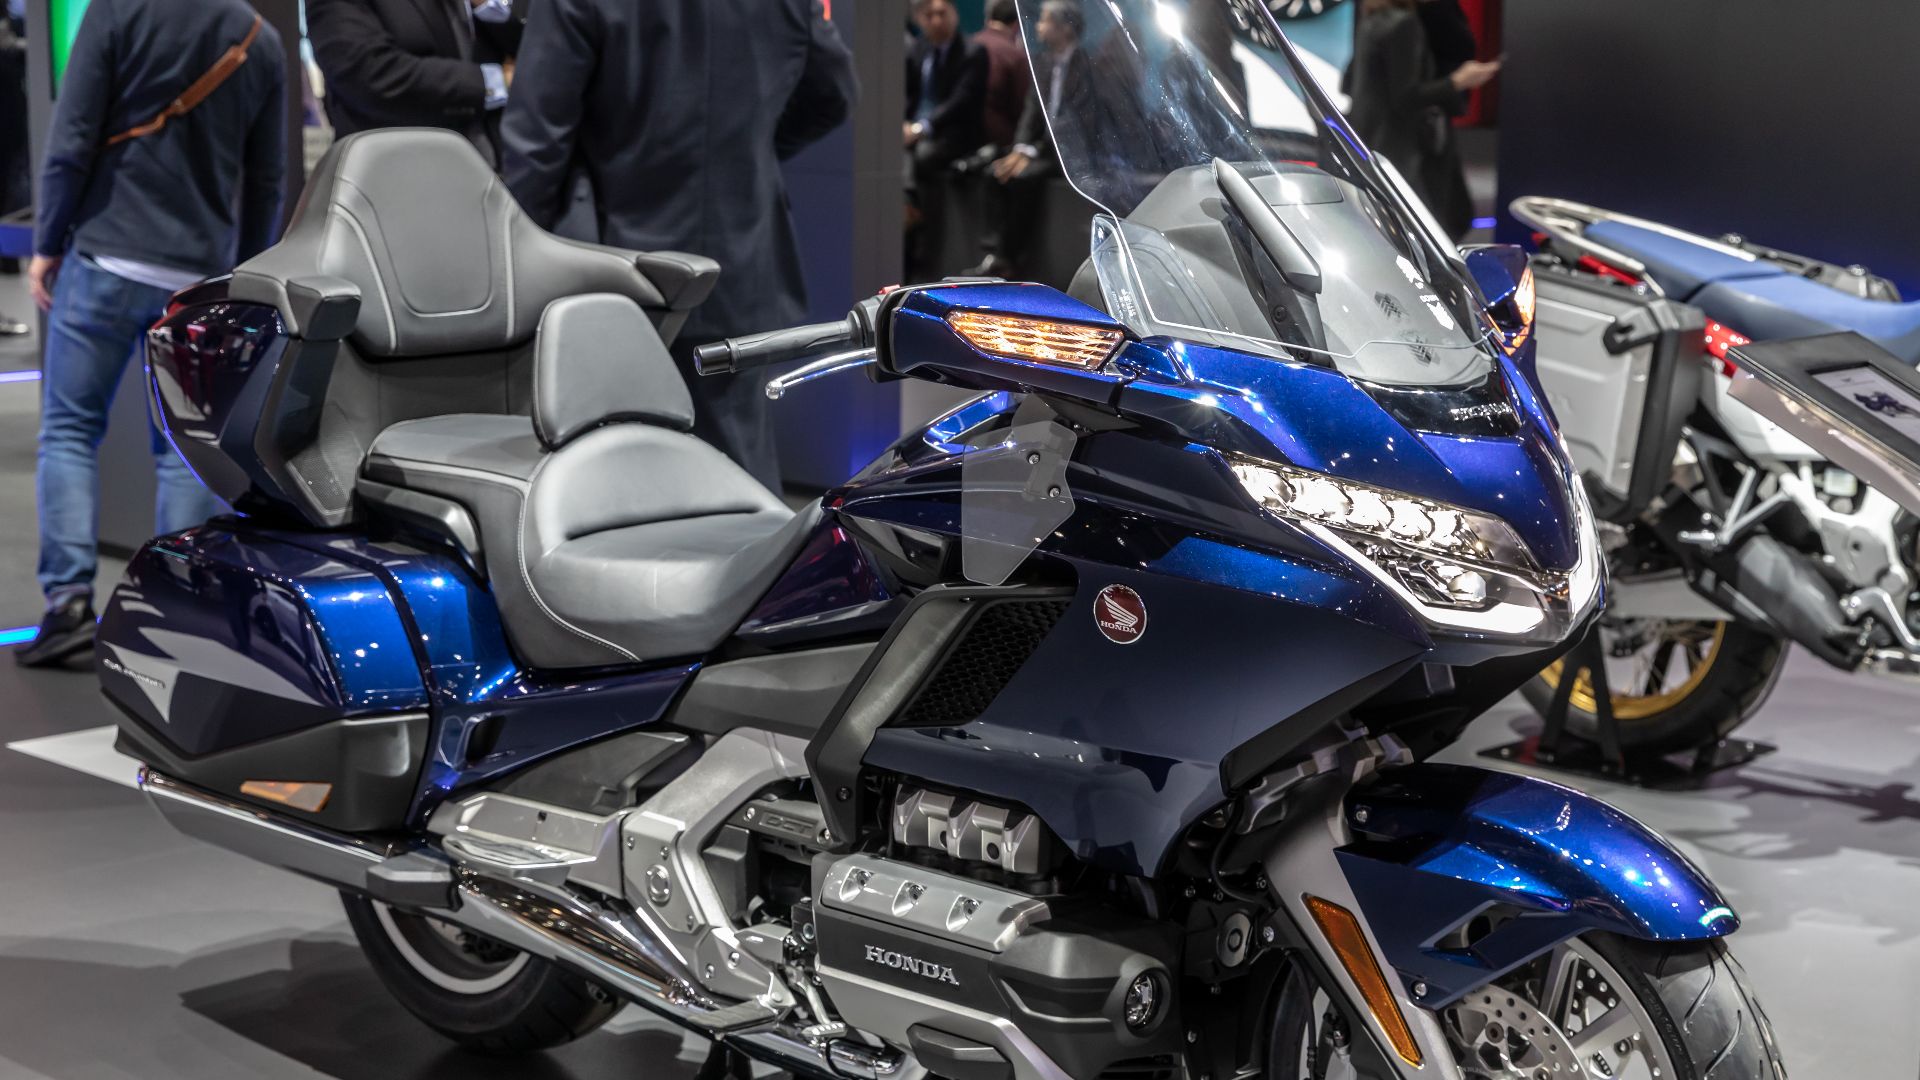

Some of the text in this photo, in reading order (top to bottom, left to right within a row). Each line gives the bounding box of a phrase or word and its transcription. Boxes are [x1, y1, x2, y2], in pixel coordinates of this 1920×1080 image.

[1100, 620, 1138, 634] HONDA
[759, 811, 813, 839] DCT
[864, 944, 960, 986] HONDA
